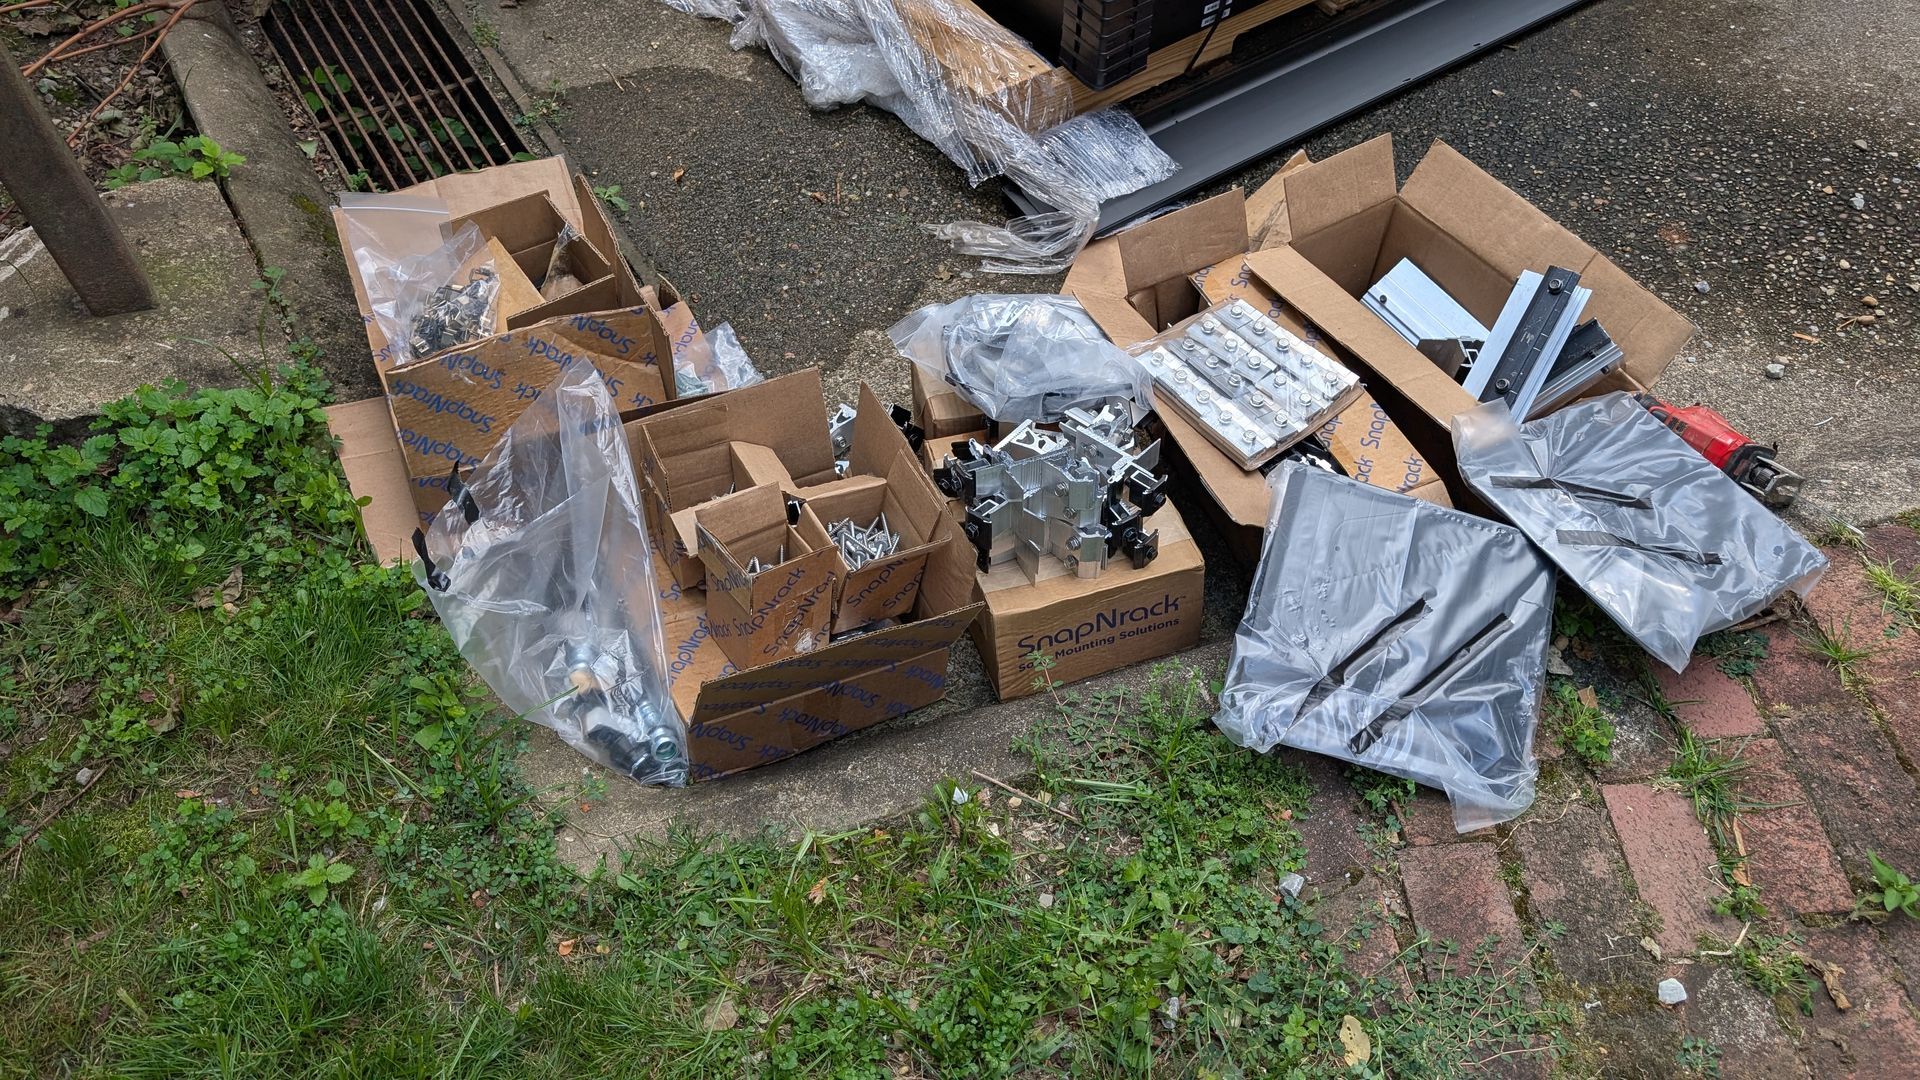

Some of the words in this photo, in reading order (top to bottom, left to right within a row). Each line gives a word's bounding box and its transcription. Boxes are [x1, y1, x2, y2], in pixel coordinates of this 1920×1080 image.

[392, 379, 497, 433] SnapNrack
[1018, 594, 1180, 658] SnapNrack
[1055, 636, 1115, 660] Mounting
[1119, 617, 1180, 640] Solutions
